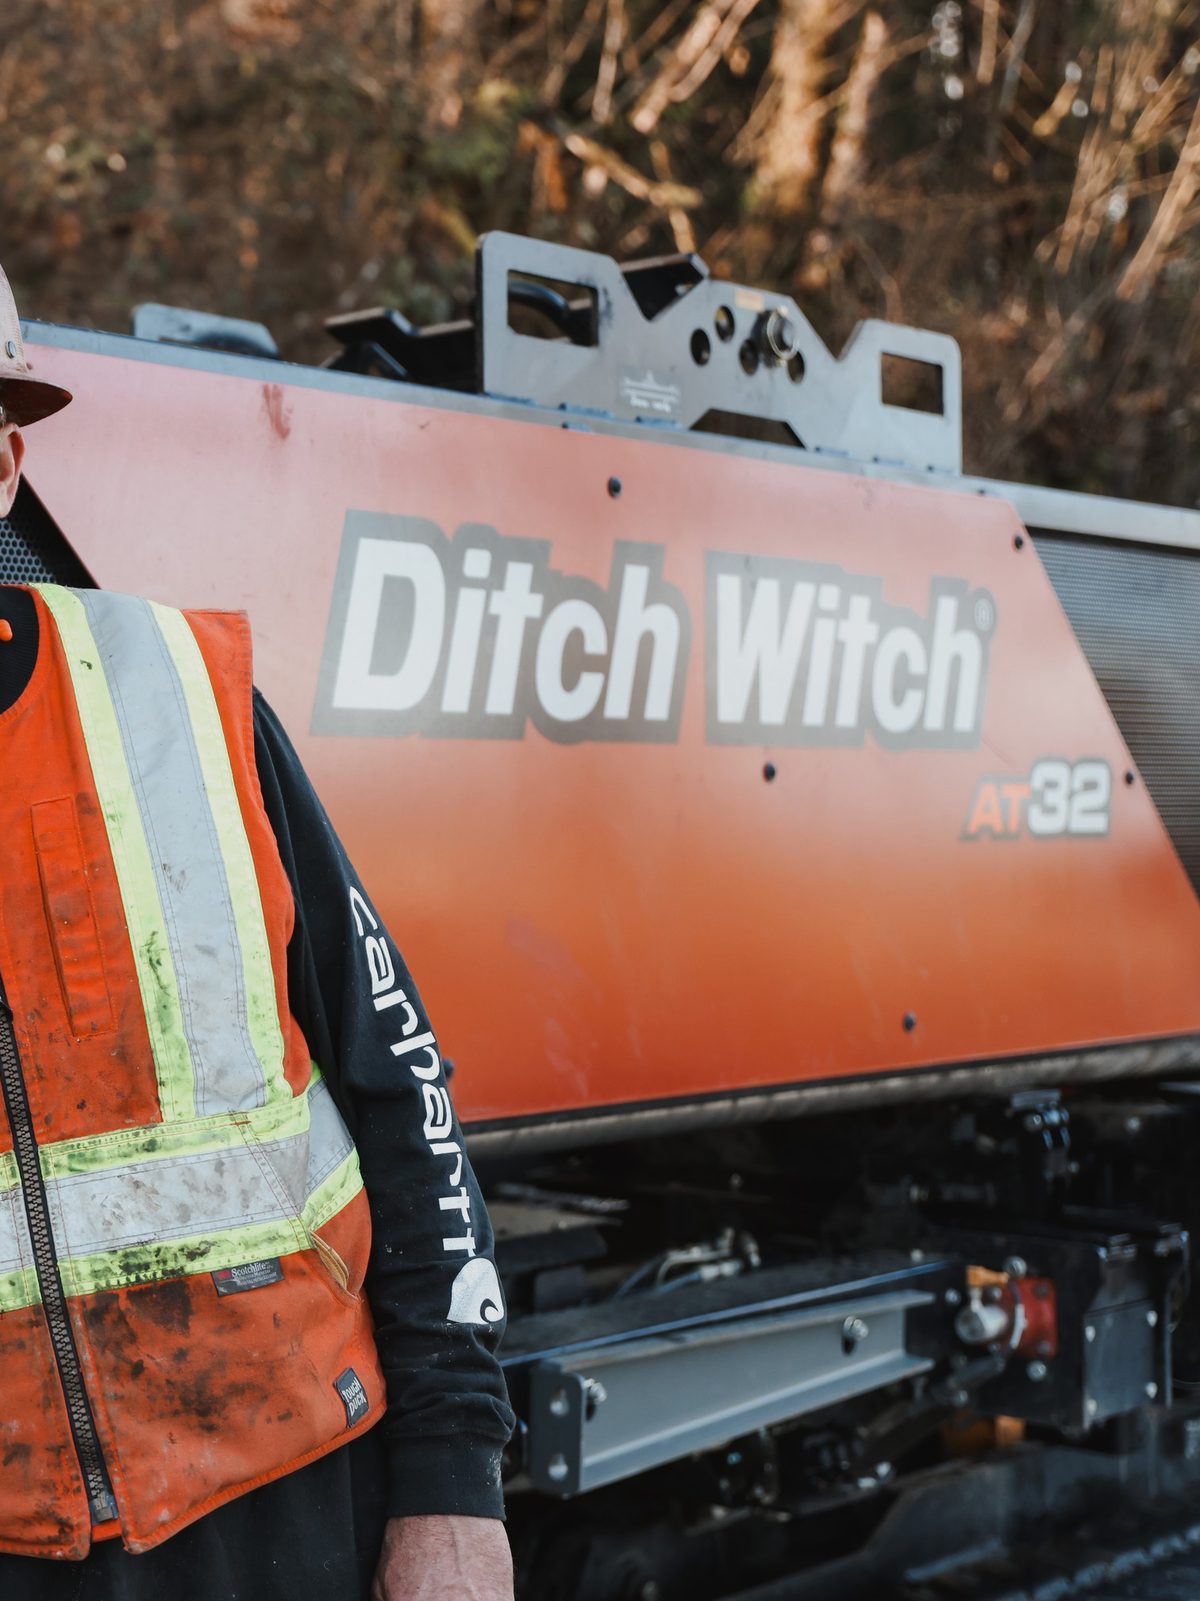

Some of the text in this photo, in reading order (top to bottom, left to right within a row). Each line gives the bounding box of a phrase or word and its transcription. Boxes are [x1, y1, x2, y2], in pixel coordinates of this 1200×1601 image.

[332, 536, 681, 722] Ditch
[966, 759, 1112, 835] AT32
[231, 1261, 266, 1278] Scotchlite
[341, 1376, 362, 1403] TOUGH
[348, 1390, 367, 1417] DUCK
